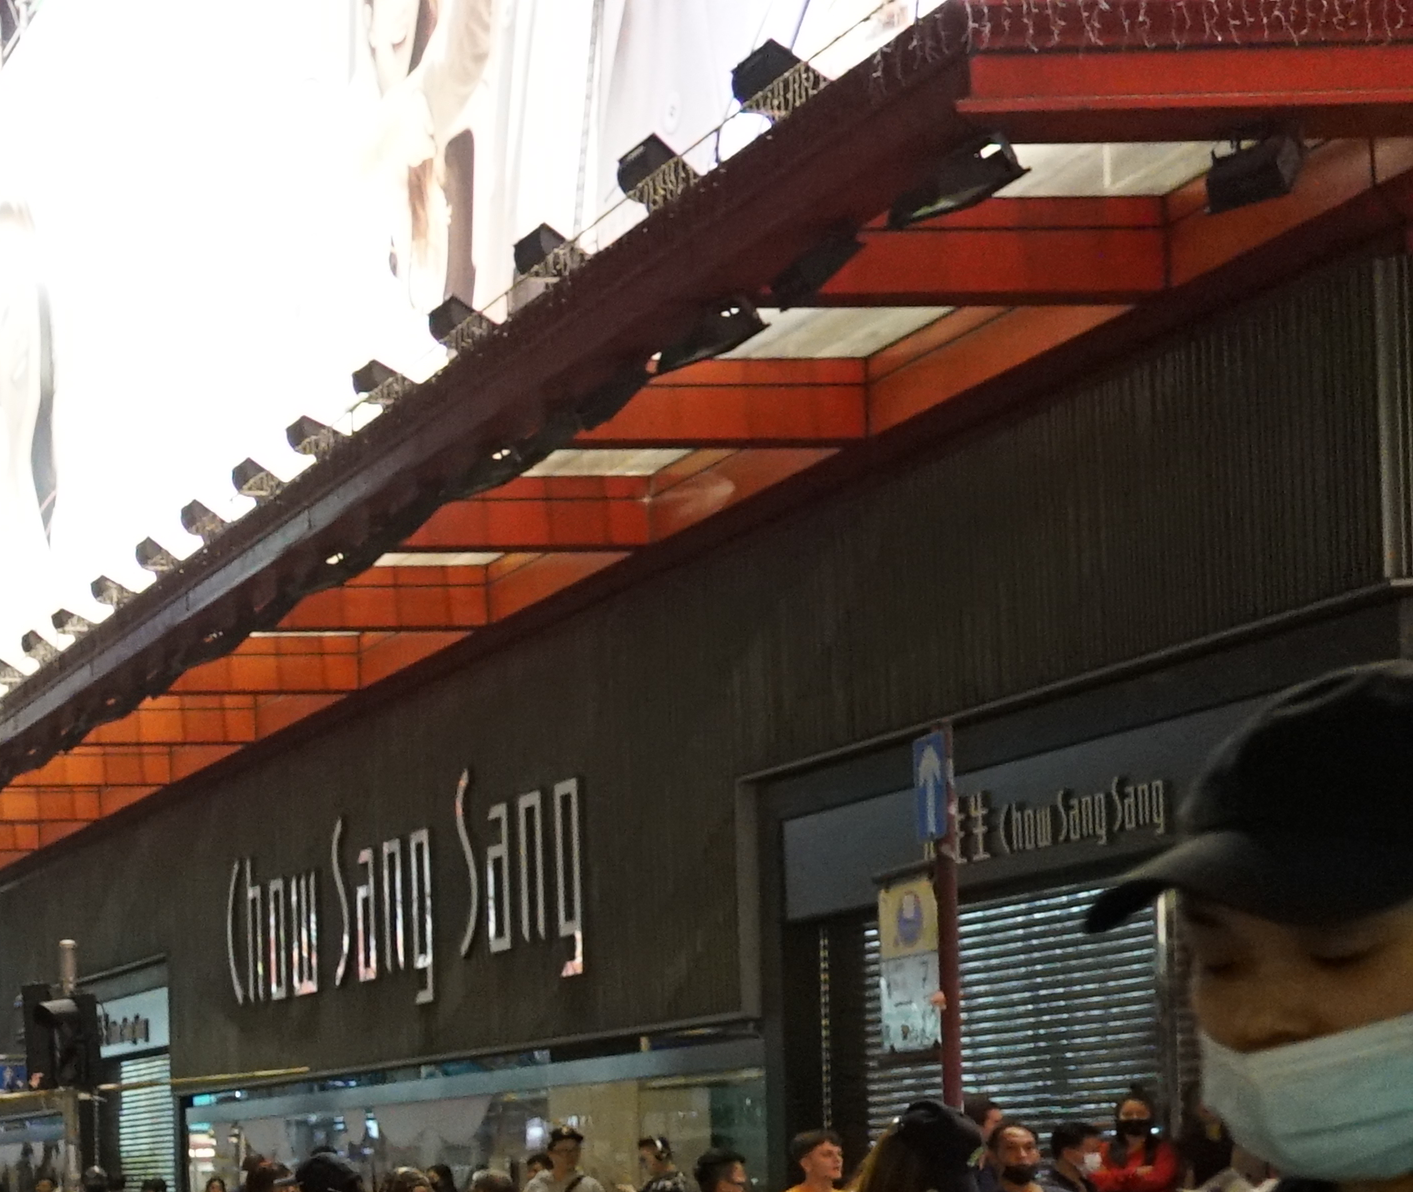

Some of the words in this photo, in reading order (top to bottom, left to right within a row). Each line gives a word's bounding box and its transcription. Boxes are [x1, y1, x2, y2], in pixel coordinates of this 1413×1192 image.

[227, 857, 318, 1006] Chow
[331, 815, 434, 1005] Sang
[455, 767, 584, 979] Sang
[999, 802, 1053, 854] Chow
[1057, 789, 1108, 846] Sang
[1112, 775, 1166, 836] Sang
